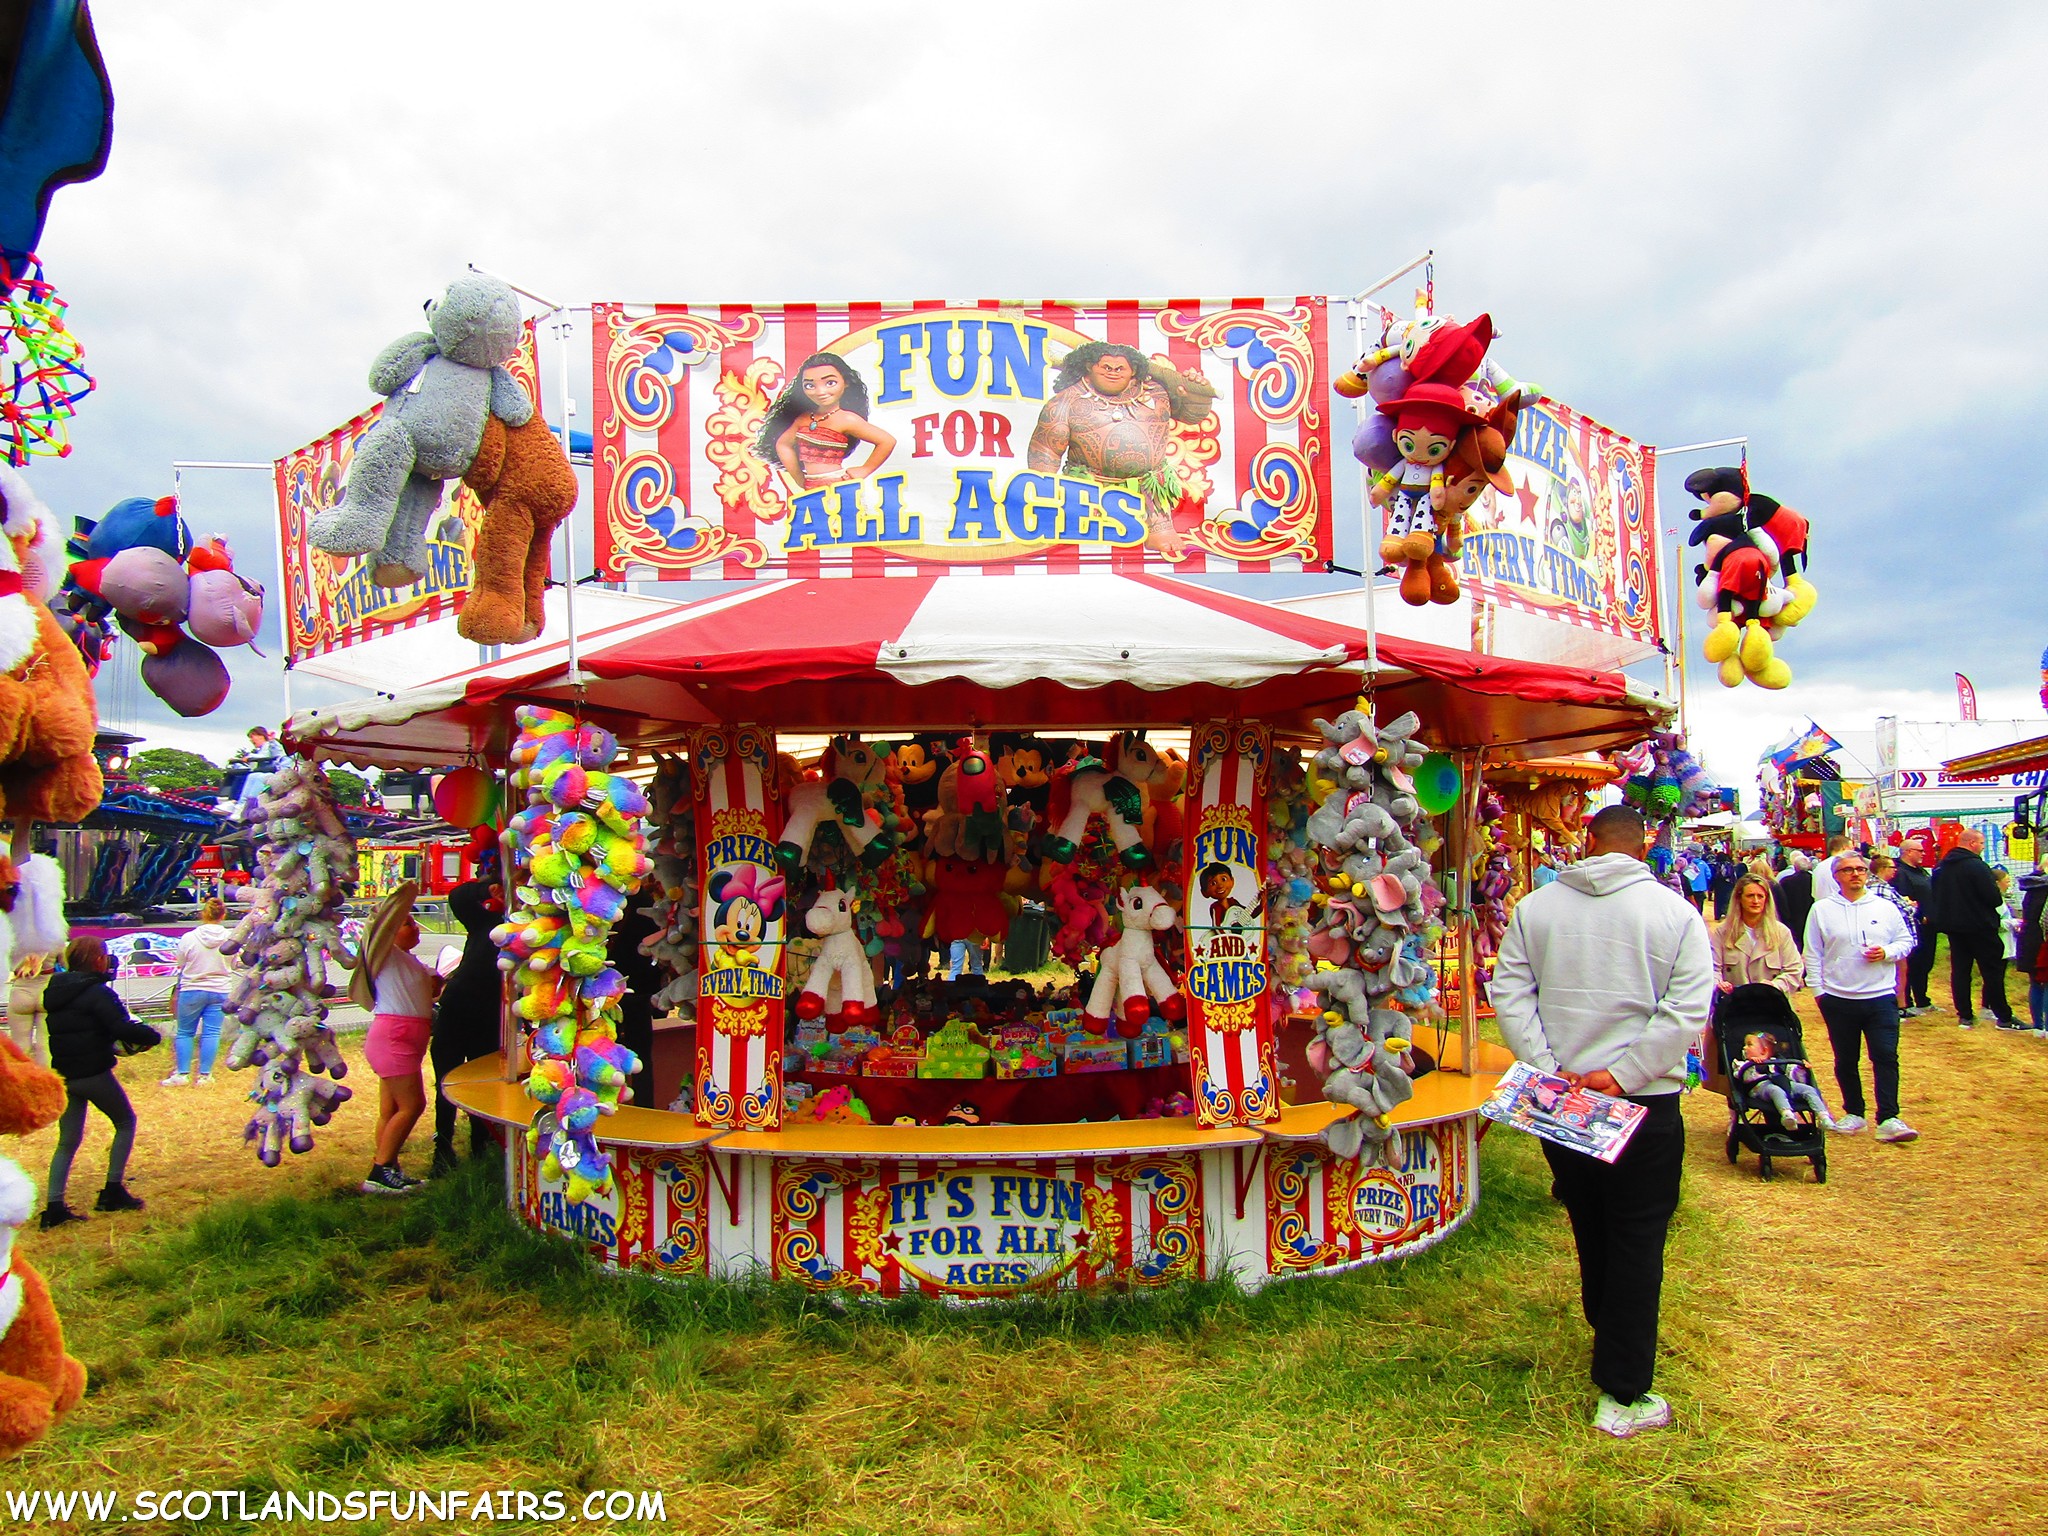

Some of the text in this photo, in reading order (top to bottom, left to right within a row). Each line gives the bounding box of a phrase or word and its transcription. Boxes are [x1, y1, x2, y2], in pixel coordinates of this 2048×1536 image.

[876, 319, 1048, 404] FUN
[911, 409, 1014, 459] FOR
[1506, 406, 1567, 482] RIZE
[782, 469, 1148, 549] ALL AGES
[1463, 532, 1601, 610] EVERY TIME
[706, 834, 776, 873] PRIZE
[1195, 826, 1257, 872] FUN
[1210, 936, 1245, 958] AND
[701, 968, 783, 997] EVERY TIME
[1189, 962, 1265, 1002] GAMES
[1400, 1130, 1427, 1173] UN
[540, 1191, 617, 1248] GAMES
[889, 1172, 1083, 1225] IT'S FUN
[1353, 1208, 1406, 1228] EVERY TIME
[1355, 1187, 1404, 1211] PRIZE
[909, 1225, 1065, 1256] FOR ALL
[945, 1263, 1029, 1285] AGES
